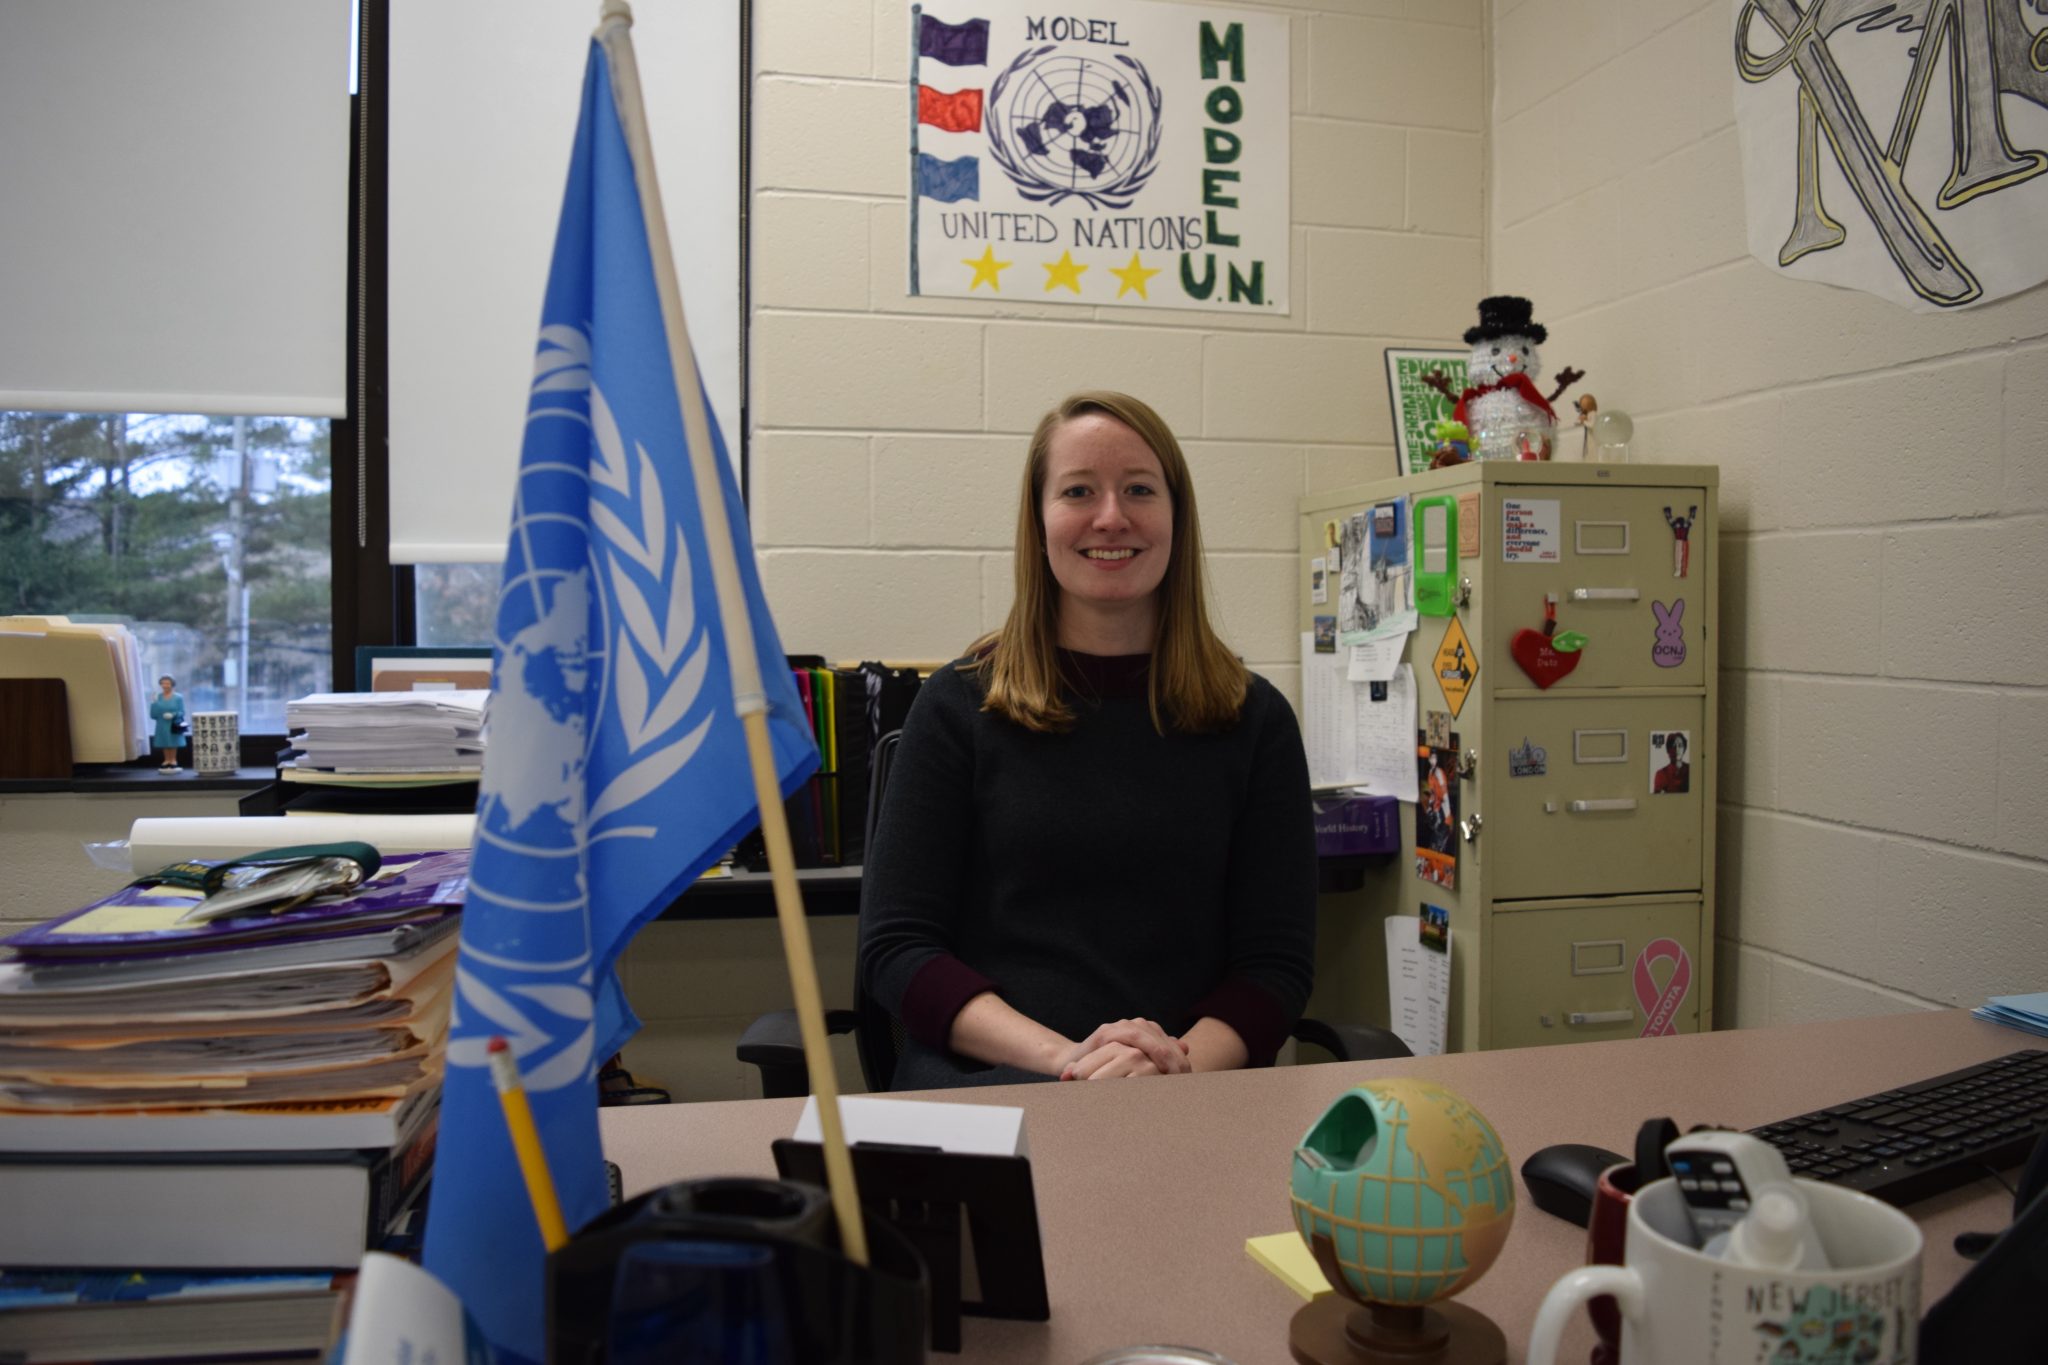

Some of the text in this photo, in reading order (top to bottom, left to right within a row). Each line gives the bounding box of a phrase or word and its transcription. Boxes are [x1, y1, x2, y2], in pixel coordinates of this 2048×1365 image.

[1026, 16, 1129, 46] MODEL
[1199, 21, 1246, 247] MODEL
[941, 212, 1203, 251] UNITED NATIONS
[1397, 357, 1468, 376] EDUCATI
[1654, 645, 1684, 656] OCNJ
[1512, 765, 1546, 776] LONDON
[1338, 824, 1369, 835] History
[1649, 986, 1682, 1031] TOYOTA
[1746, 1281, 1811, 1314] NEW
[1822, 1277, 1904, 1318] JERSEY
